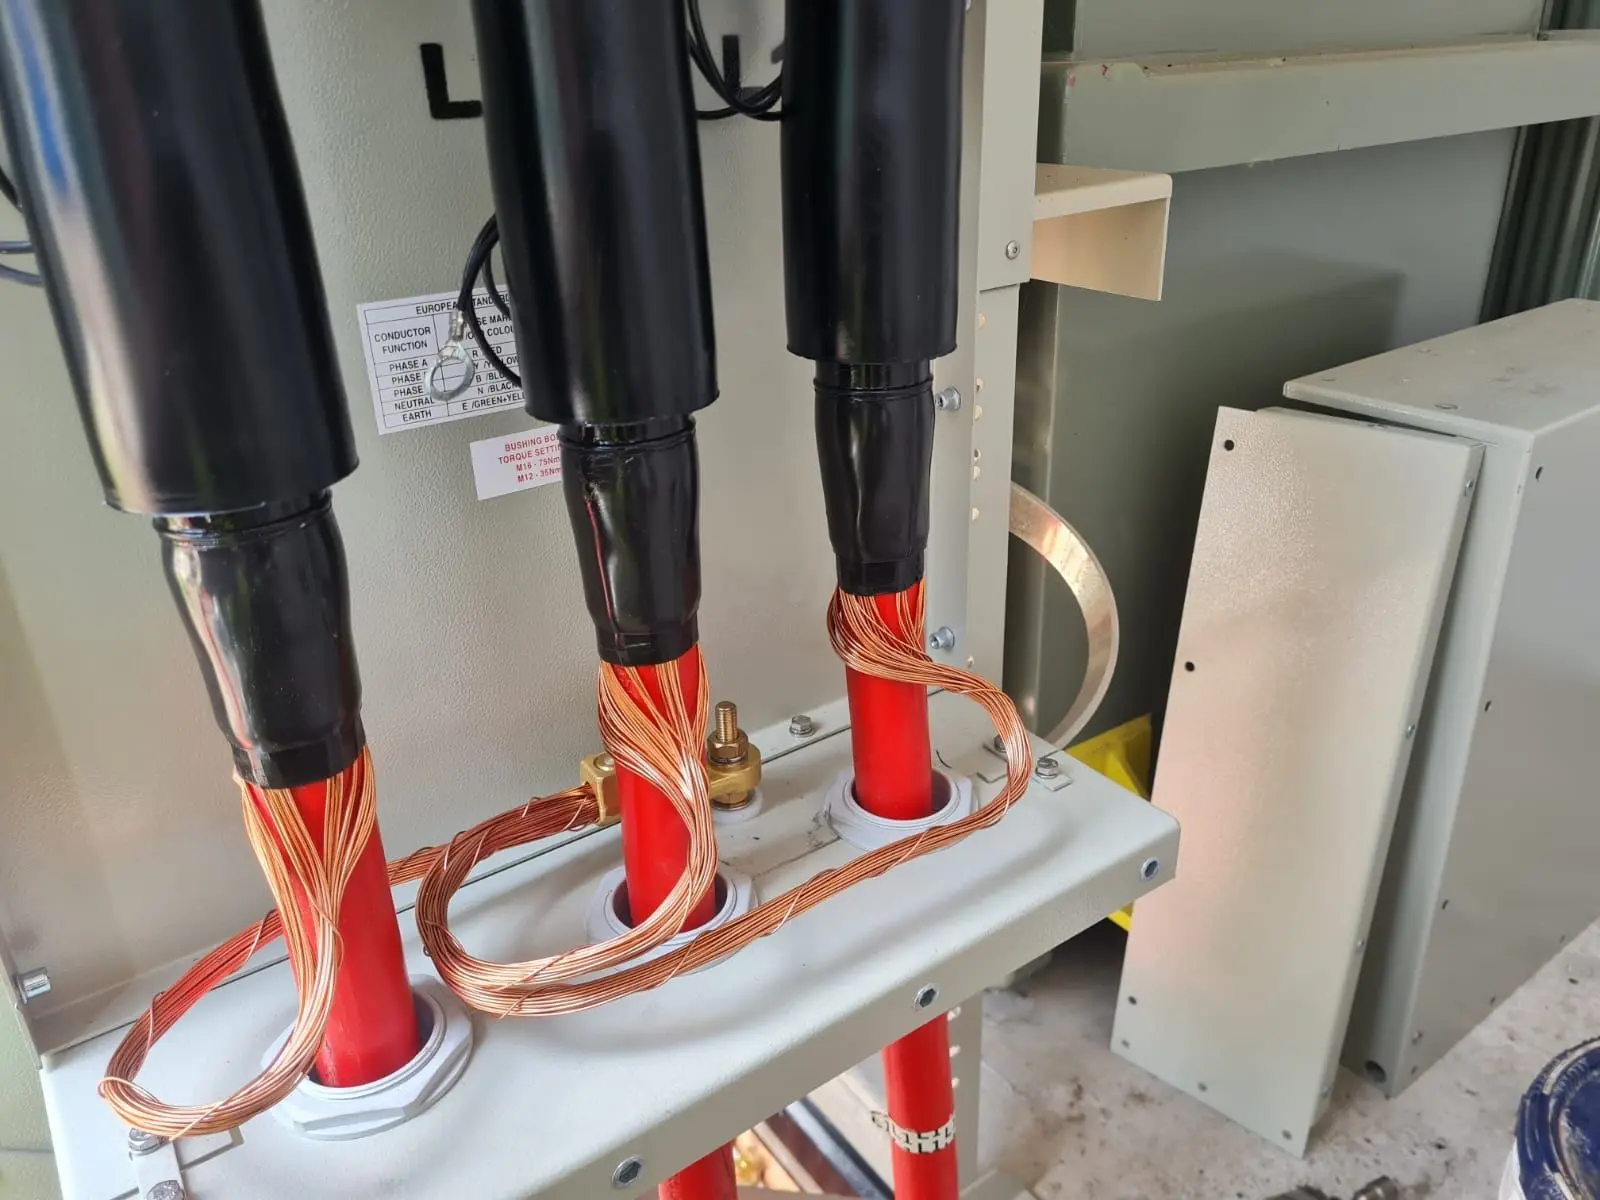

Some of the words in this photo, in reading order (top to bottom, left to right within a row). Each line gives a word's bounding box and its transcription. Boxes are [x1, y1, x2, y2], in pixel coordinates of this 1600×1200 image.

[722, 35, 785, 103] L
[416, 301, 459, 314] EUROPEA
[374, 327, 431, 343] CONDUCTOR
[382, 341, 428, 354] FUNCTION
[472, 350, 478, 358] R
[389, 360, 419, 372] PHASE
[422, 359, 428, 367] A
[391, 372, 422, 385] PHASE
[475, 374, 482, 383] B
[394, 385, 424, 397] PHASE
[478, 387, 484, 395] N
[394, 397, 435, 411] NEUTRAL
[462, 402, 468, 411] E
[402, 409, 432, 422] EARTH
[504, 437, 542, 452] BUSHING
[498, 450, 533, 464] TORQUE
[516, 463, 532, 472] M16
[517, 473, 533, 483] M12
